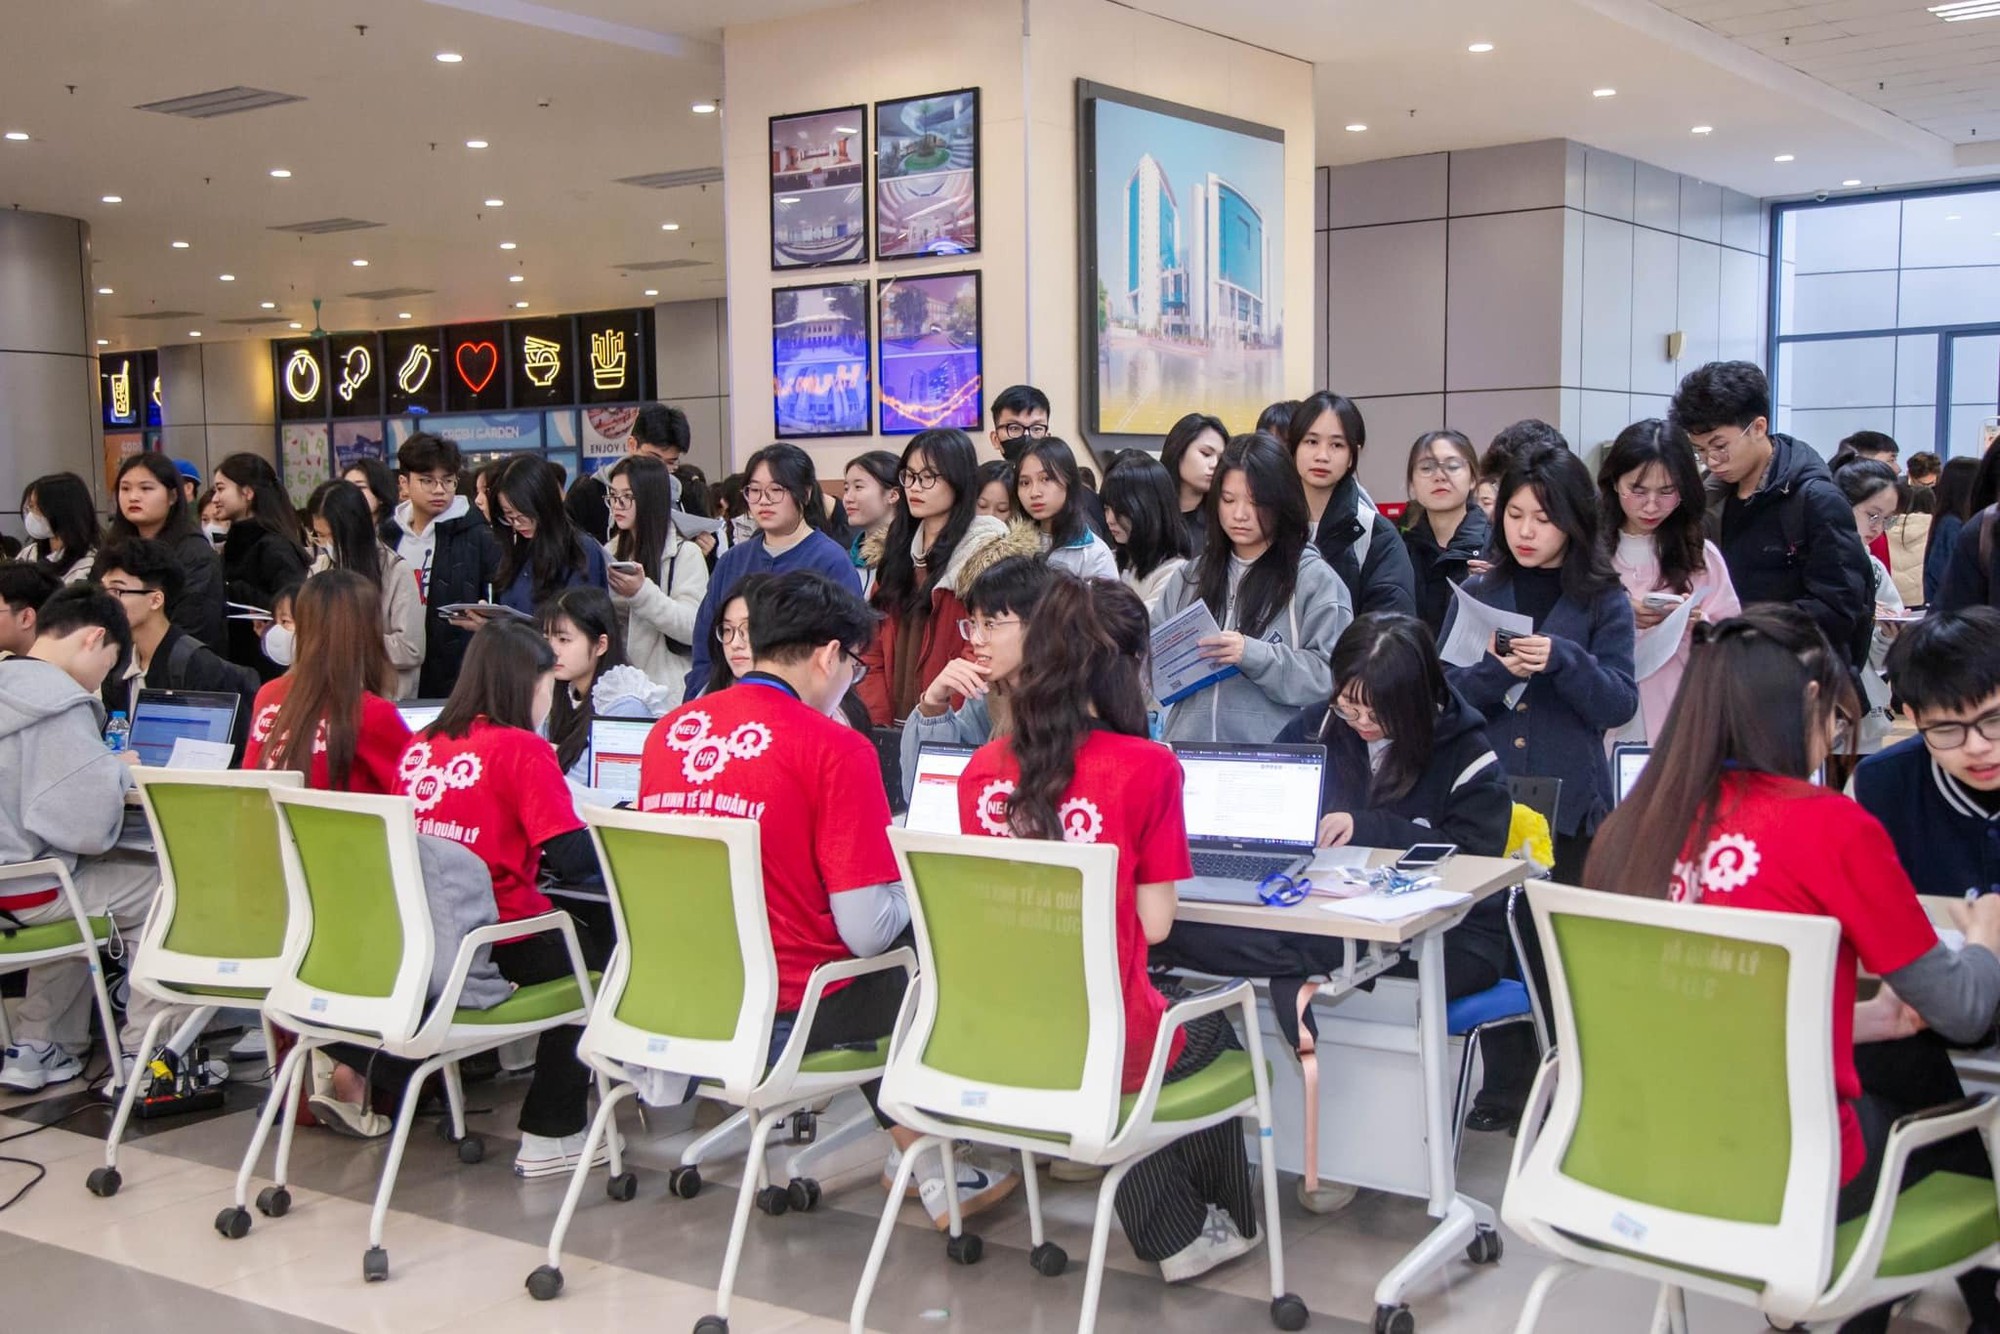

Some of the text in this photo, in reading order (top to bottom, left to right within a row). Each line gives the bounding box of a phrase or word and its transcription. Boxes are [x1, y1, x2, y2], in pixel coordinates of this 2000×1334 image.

[476, 426, 519, 439] GARDEN
[590, 443, 619, 454] ENJOY
[260, 718, 275, 729] NE
[676, 724, 700, 735] NEU
[695, 751, 716, 767] HR
[417, 780, 435, 795] HR
[686, 789, 701, 809] TẾ
[699, 789, 714, 808] VÀ
[715, 793, 748, 816] QUẢN
[748, 802, 766, 820] LÝ
[423, 818, 434, 835] VÀ
[434, 820, 462, 841] QUẢN
[464, 826, 480, 844] LÝ
